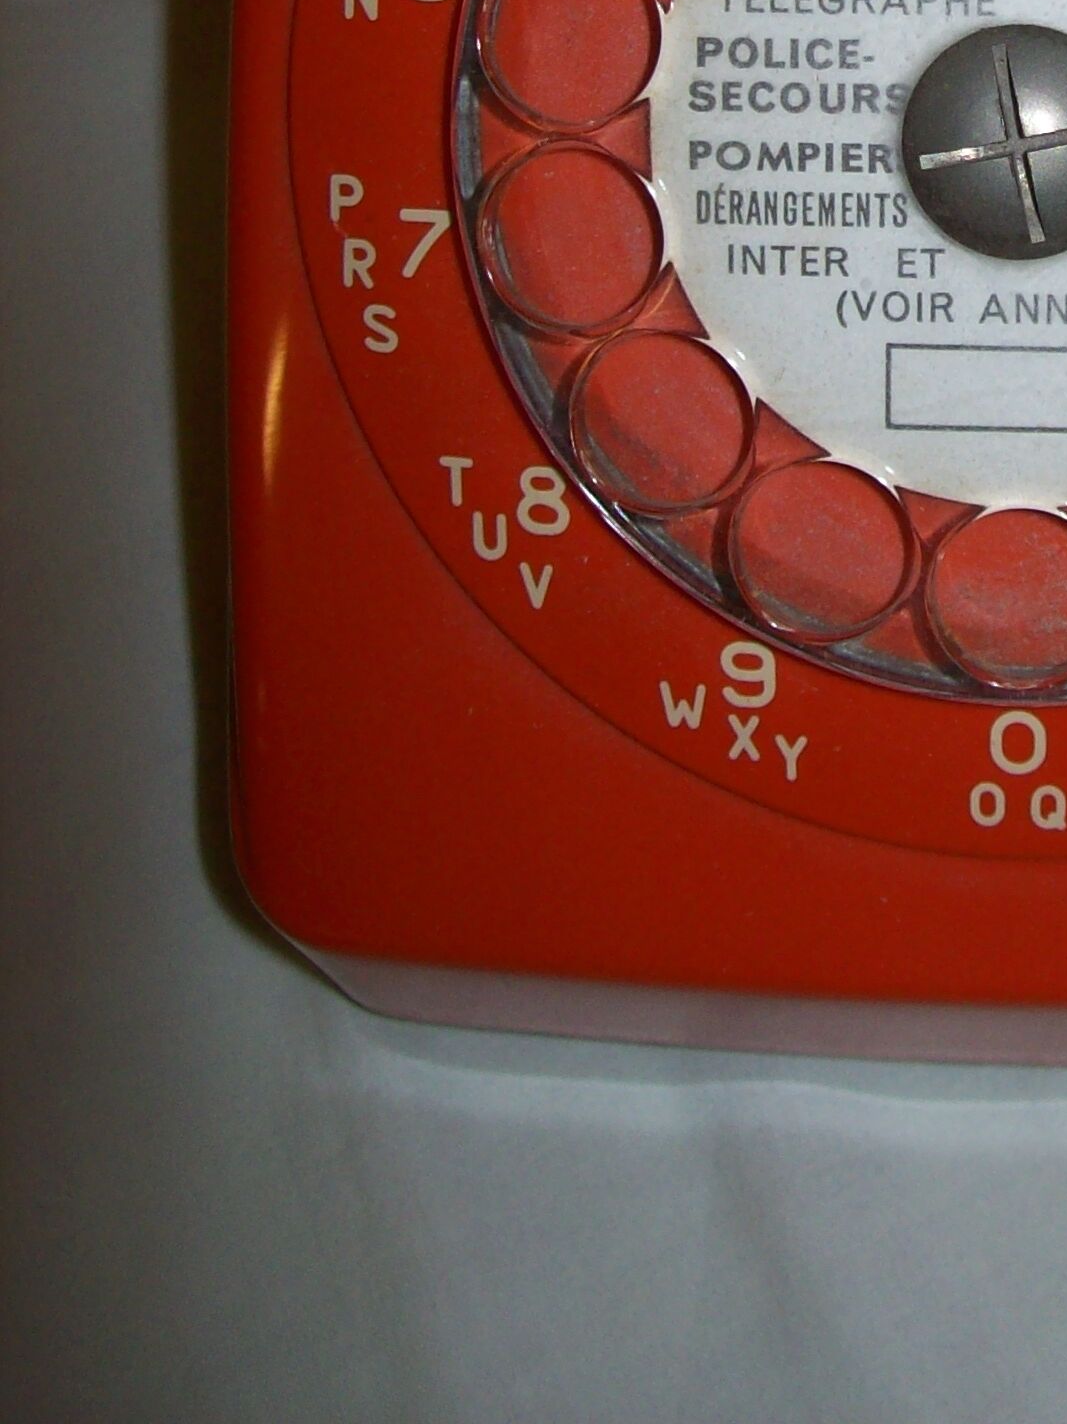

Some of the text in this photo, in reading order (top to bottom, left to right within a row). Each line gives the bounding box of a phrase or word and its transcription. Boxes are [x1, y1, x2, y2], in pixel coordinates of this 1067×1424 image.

[695, 35, 877, 73] POLICE-
[687, 79, 908, 117] SECOURS
[695, 183, 909, 231] DÉRANGEMENTS
[398, 207, 452, 279] 7
[727, 243, 852, 280] INTER
[897, 247, 948, 281] ET
[835, 289, 957, 331] (VOIR
[515, 465, 572, 537] 8
[719, 639, 778, 709] 9
